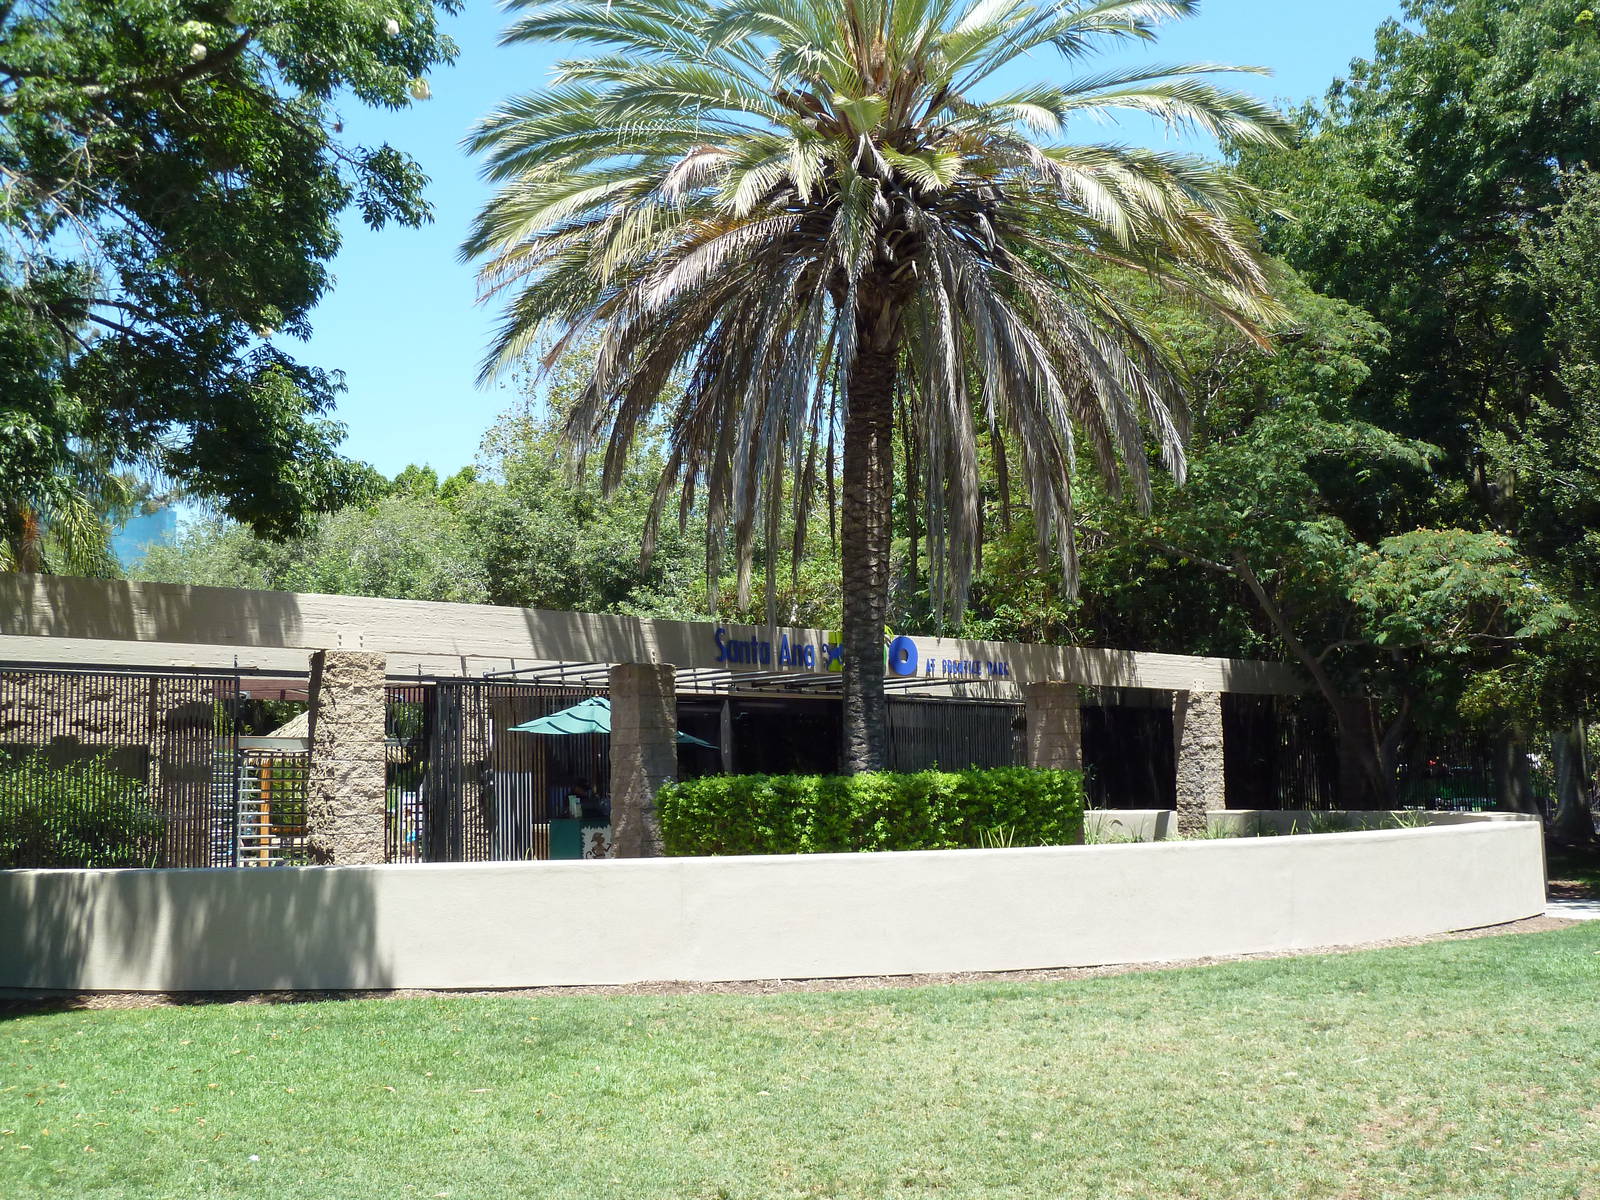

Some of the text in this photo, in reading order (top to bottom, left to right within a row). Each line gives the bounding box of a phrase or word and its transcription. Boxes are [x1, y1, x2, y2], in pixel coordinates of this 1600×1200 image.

[715, 627, 770, 665] Santa
[780, 634, 815, 668] Ana
[925, 658, 936, 672] AT
[986, 661, 1009, 676] PARK
